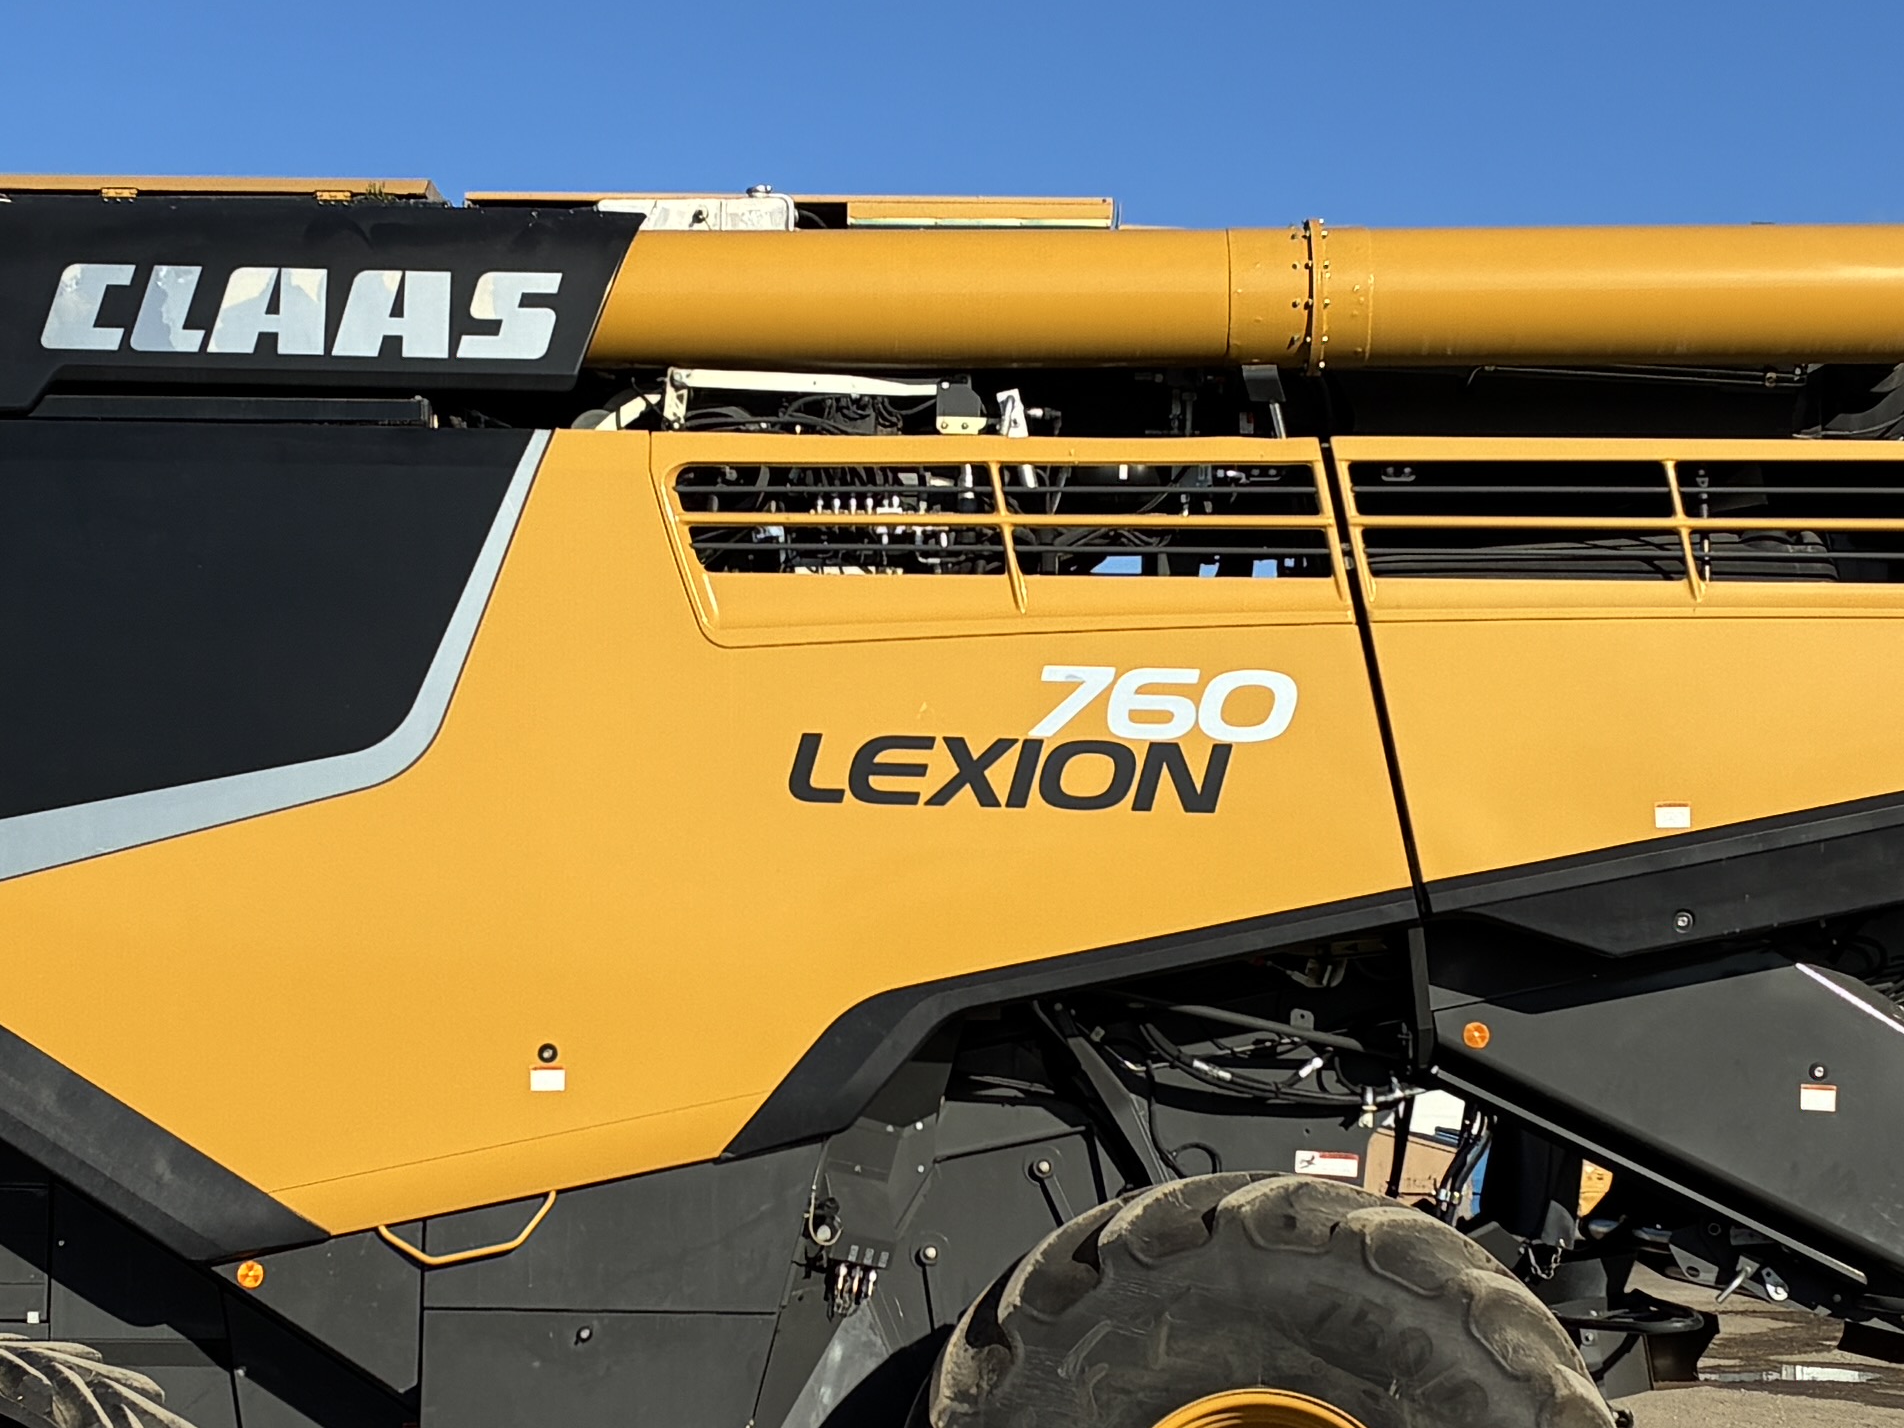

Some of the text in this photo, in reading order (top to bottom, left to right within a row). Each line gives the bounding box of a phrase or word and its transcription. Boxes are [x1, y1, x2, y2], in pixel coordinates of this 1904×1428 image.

[40, 263, 563, 360] CLAAS
[1027, 665, 1298, 743] 760
[788, 732, 1233, 814] LEXION
